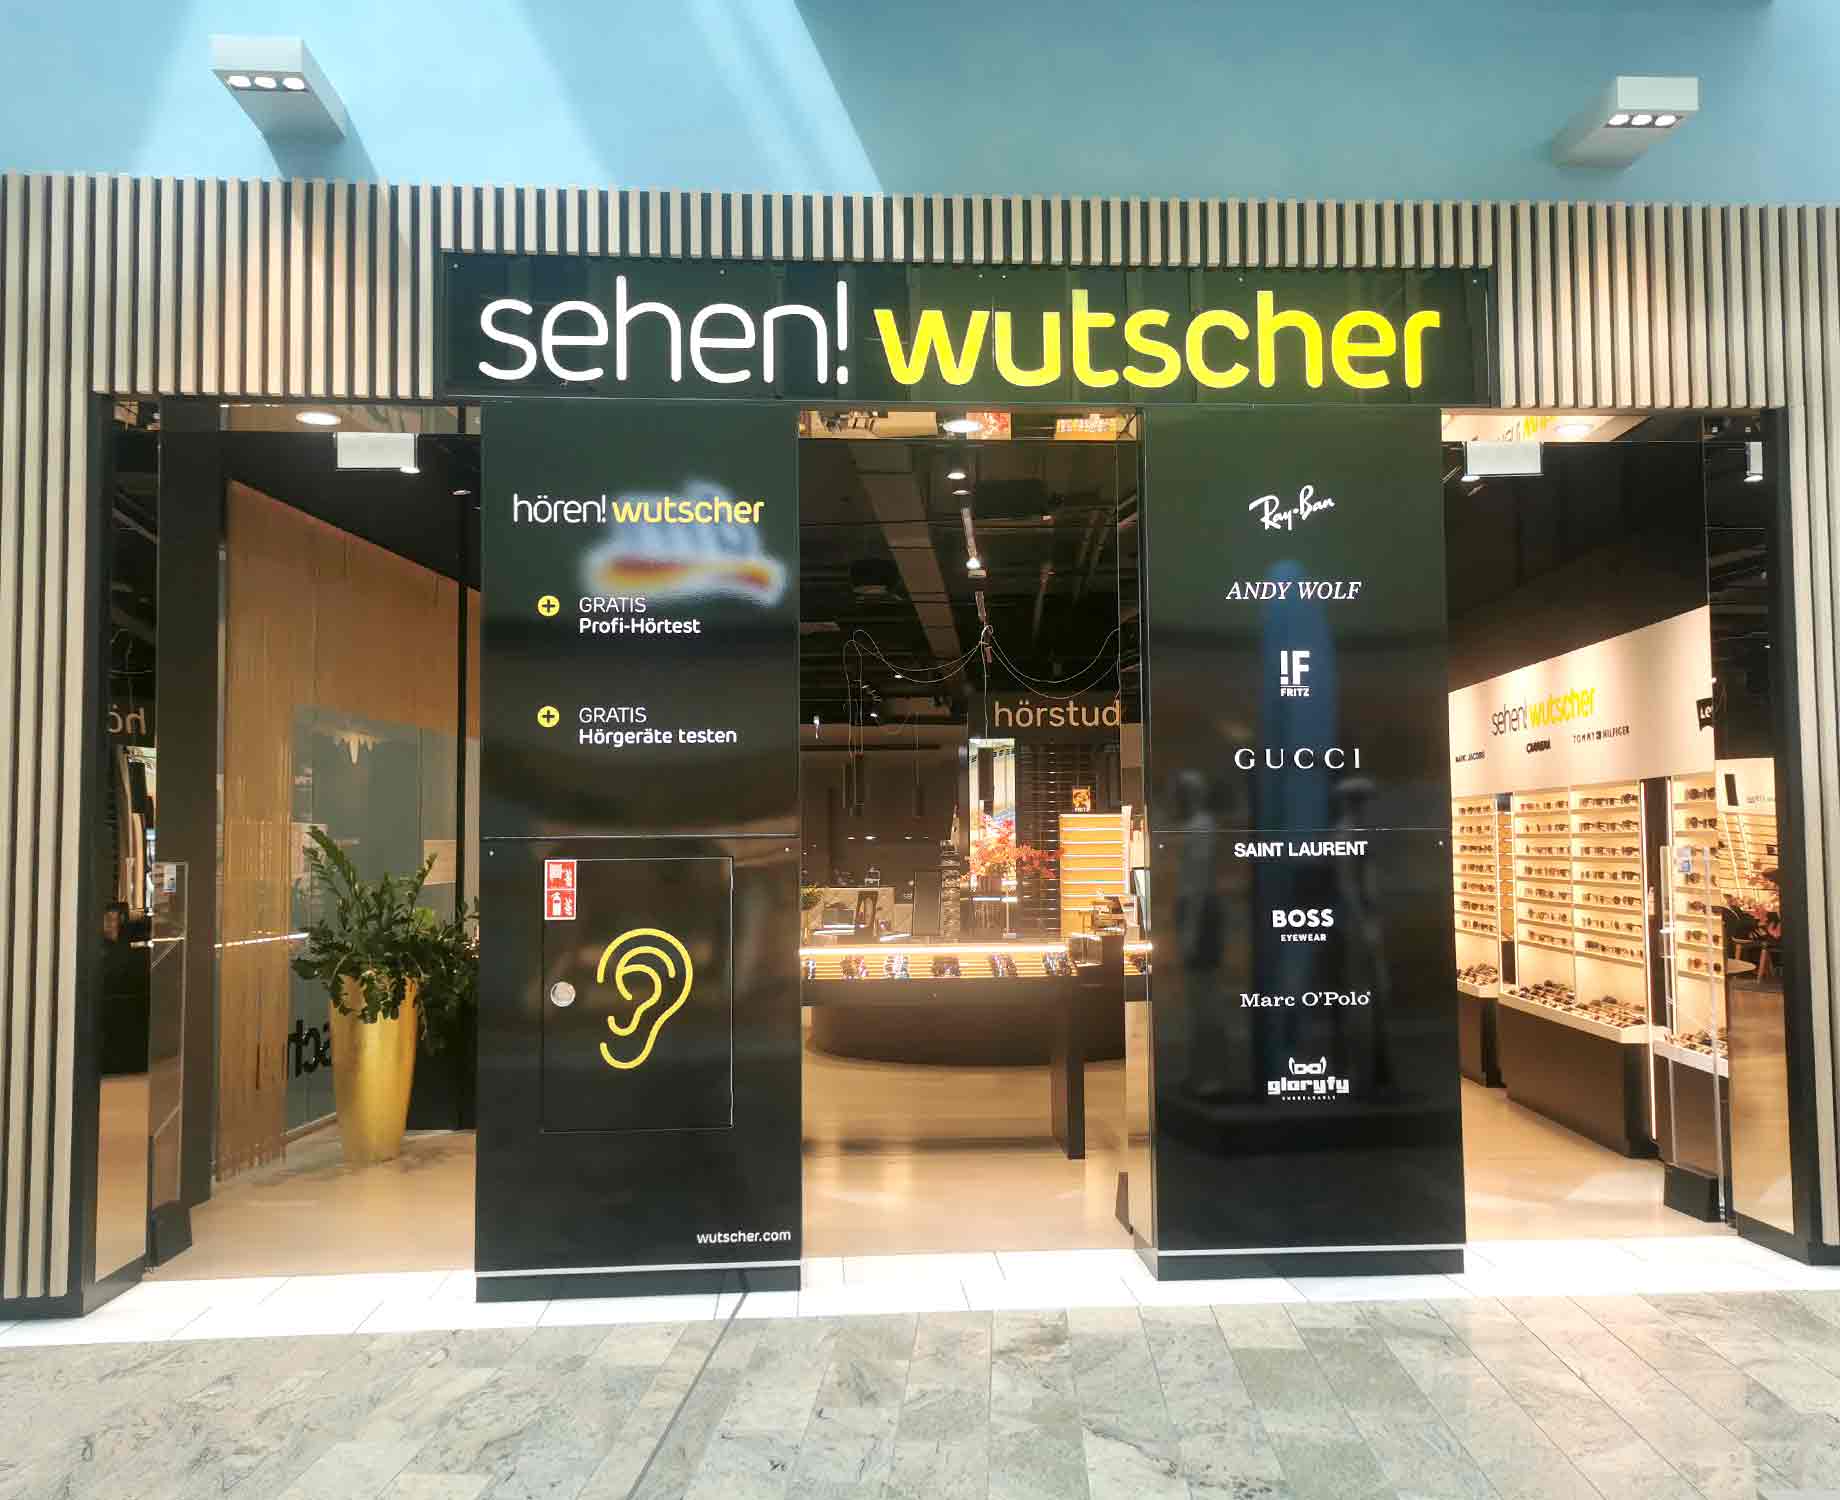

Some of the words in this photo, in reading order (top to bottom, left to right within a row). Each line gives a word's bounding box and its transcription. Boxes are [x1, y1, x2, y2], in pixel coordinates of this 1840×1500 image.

[478, 275, 849, 385] sehen!
[874, 290, 1441, 389] wutscher
[512, 493, 607, 524] hören!
[612, 495, 765, 525] wutscher
[1248, 484, 1336, 531] Ray-Ban
[1226, 581, 1292, 600] ANDY
[1297, 580, 1362, 600] WOLF
[579, 597, 647, 614] GRATIS
[579, 616, 701, 634] Profi-Hörtest
[1280, 687, 1310, 697] FRITZ
[579, 707, 647, 723] GRATIS
[1529, 687, 1596, 728] wutscher
[579, 727, 673, 748] Hörgeräte
[678, 728, 737, 744] testen
[1234, 748, 1360, 770] GUCCI
[1233, 842, 1284, 858] SAINT
[1289, 840, 1368, 857] LAURENT
[1271, 908, 1335, 928] BOSS
[1280, 933, 1326, 942] EYEWEAR
[1240, 993, 1296, 1008] Marc
[1267, 1076, 1350, 1096] gloryfy
[696, 1230, 792, 1244] wutscher.com
